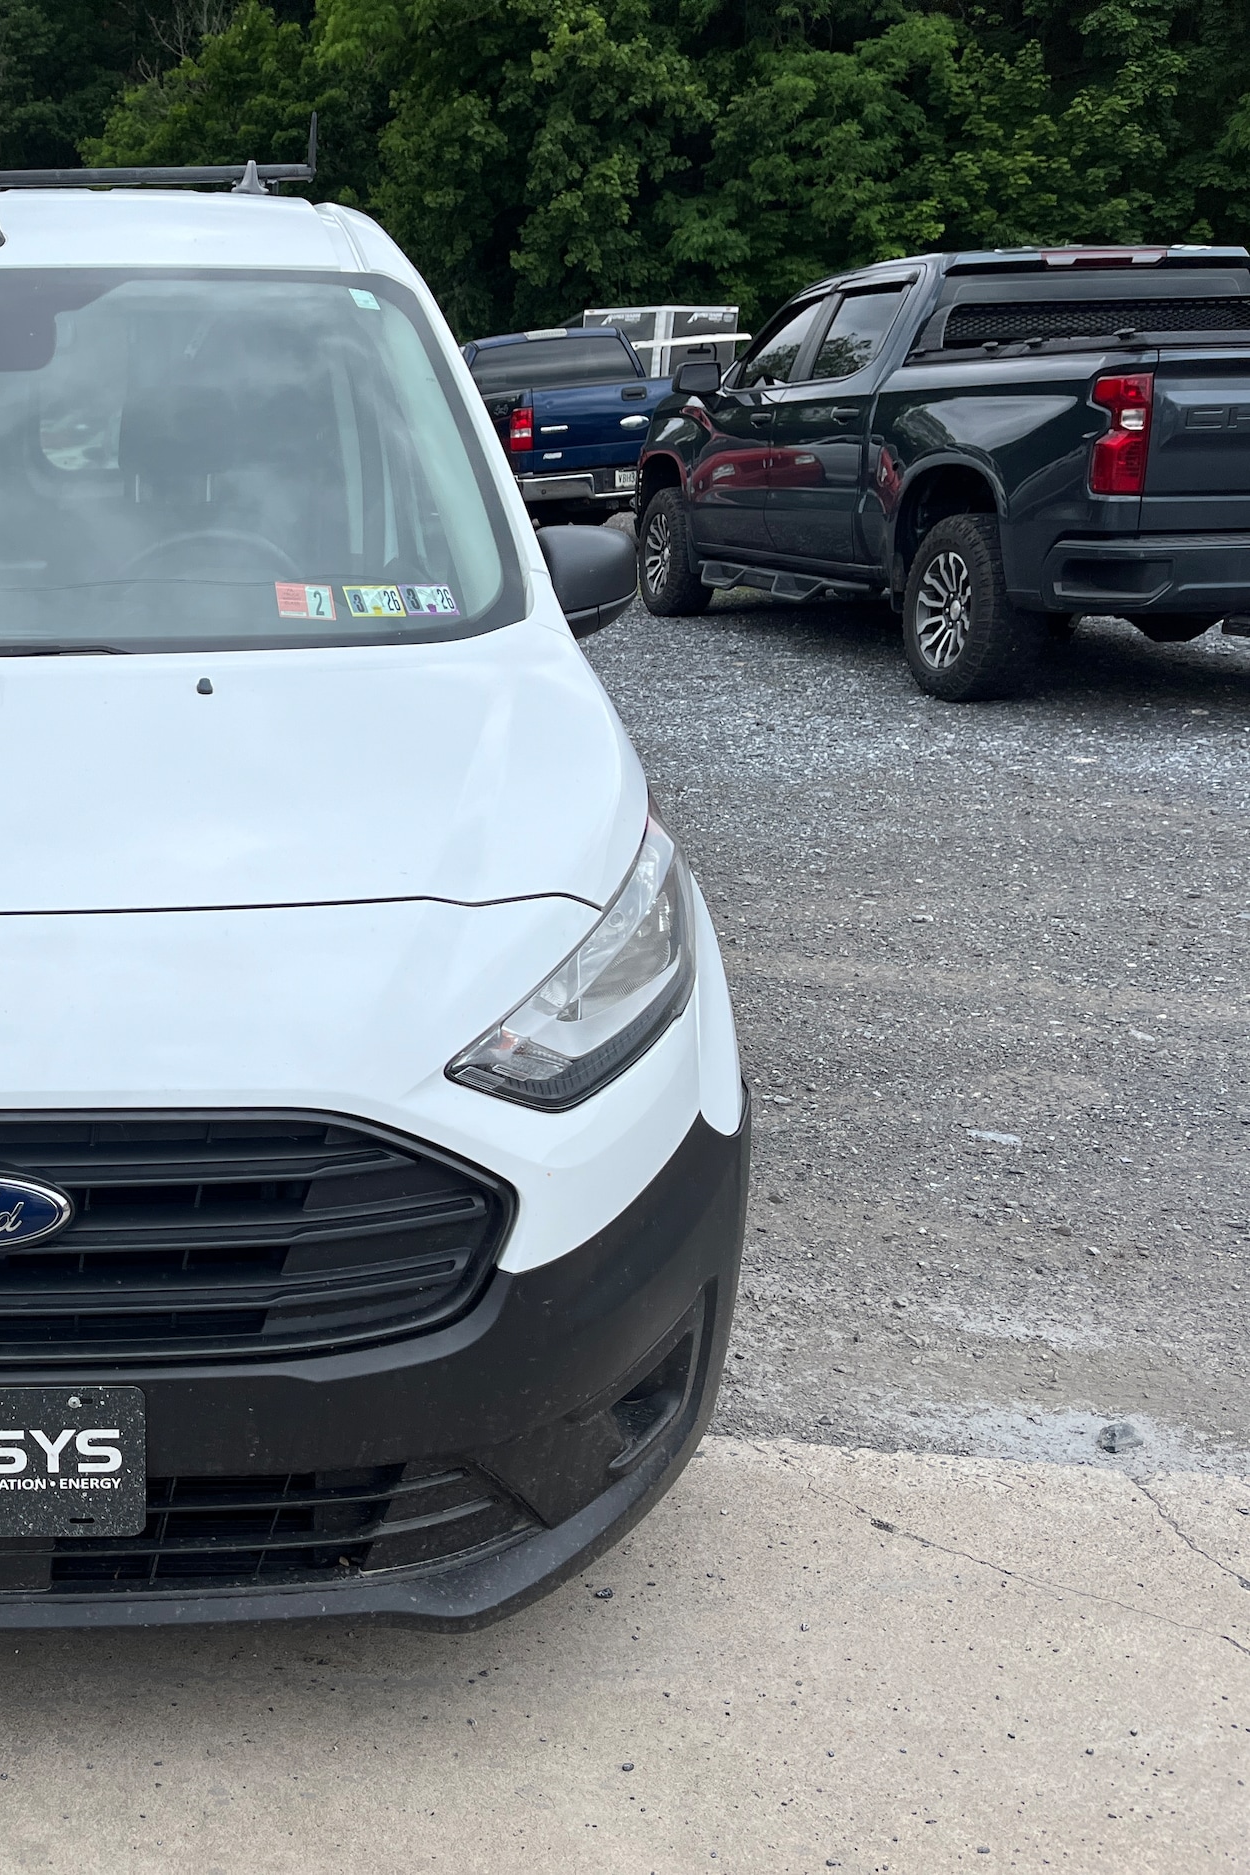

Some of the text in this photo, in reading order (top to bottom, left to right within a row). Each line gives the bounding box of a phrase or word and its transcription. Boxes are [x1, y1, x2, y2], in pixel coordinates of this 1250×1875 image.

[313, 590, 325, 616] 2
[353, 590, 401, 613] 3 26
[406, 588, 455, 610] 3 26
[59, 1477, 122, 1490] ENERGY
